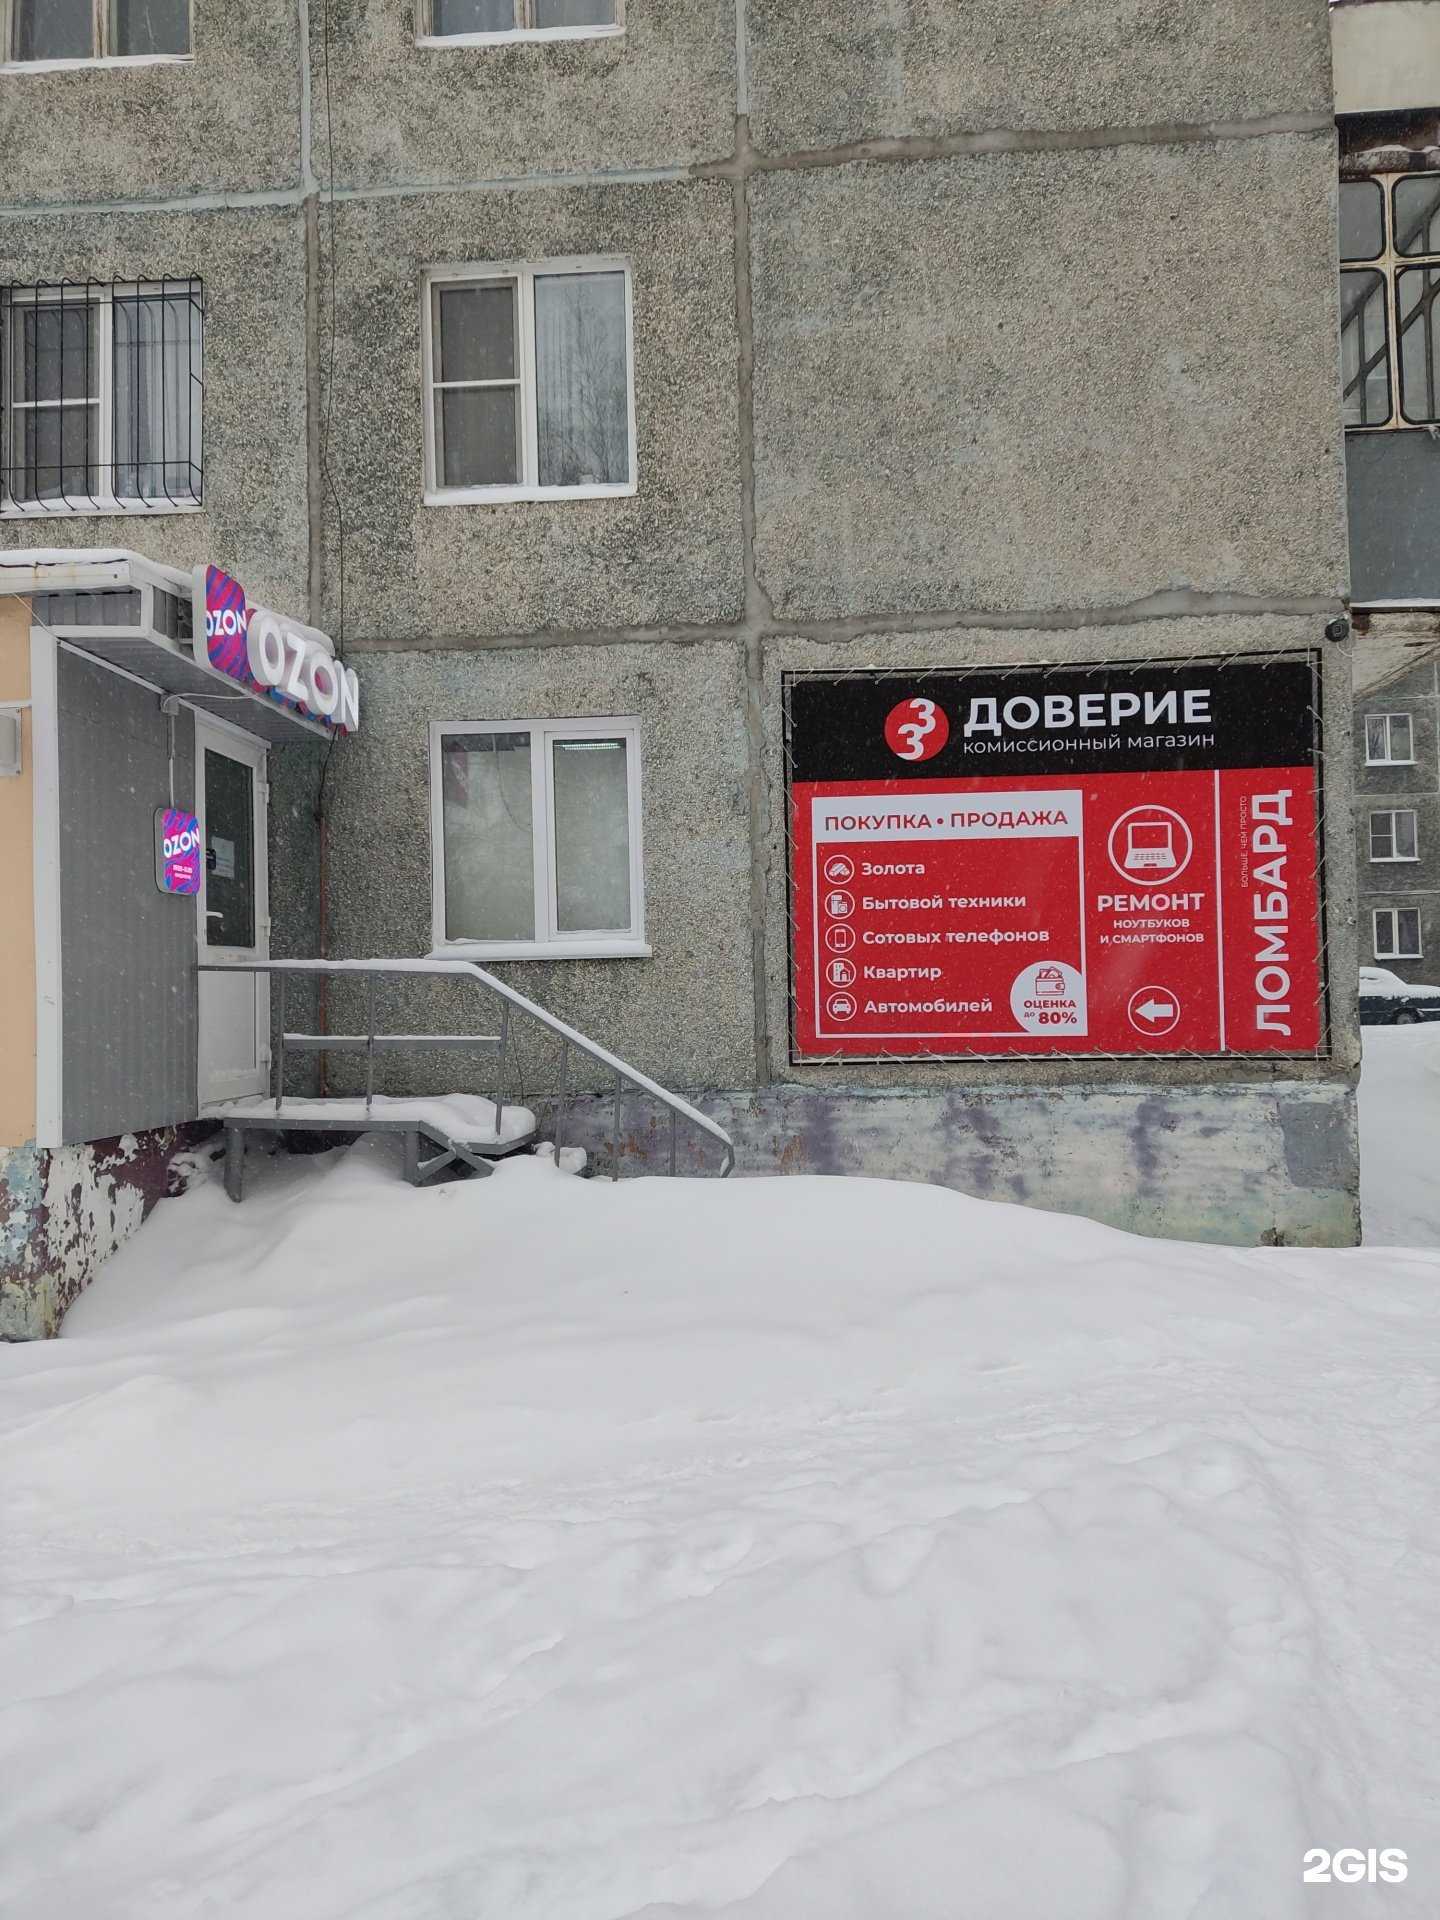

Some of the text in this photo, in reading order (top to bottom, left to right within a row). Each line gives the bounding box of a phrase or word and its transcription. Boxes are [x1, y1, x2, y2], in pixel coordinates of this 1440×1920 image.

[248, 611, 359, 731] OZON
[963, 689, 1212, 737] ДОВЕРИЕ
[963, 733, 1215, 754] комиссионный магазин
[824, 810, 1068, 831] ПОКУПКА ПРОДАЖА
[1239, 795, 1248, 829] ПРОСТО
[163, 828, 200, 858] OZON
[1240, 831, 1248, 849] ЧЕМ
[861, 862, 925, 875] Золота
[862, 895, 1026, 910] Бытовой техники
[1097, 893, 1205, 912] РЕМОНТ
[1252, 789, 1294, 1036] ЛОМБАРД
[1113, 918, 1190, 929] НОУТБУКОВ
[863, 929, 1050, 945] Сотовых телефонов
[1100, 933, 1205, 944] И СМАРТФОНОВ
[863, 965, 942, 981] Квартир
[864, 997, 993, 1014] Автомобилей
[1023, 999, 1077, 1009] ОЦЕНКА
[1038, 1011, 1078, 1025] 80%
